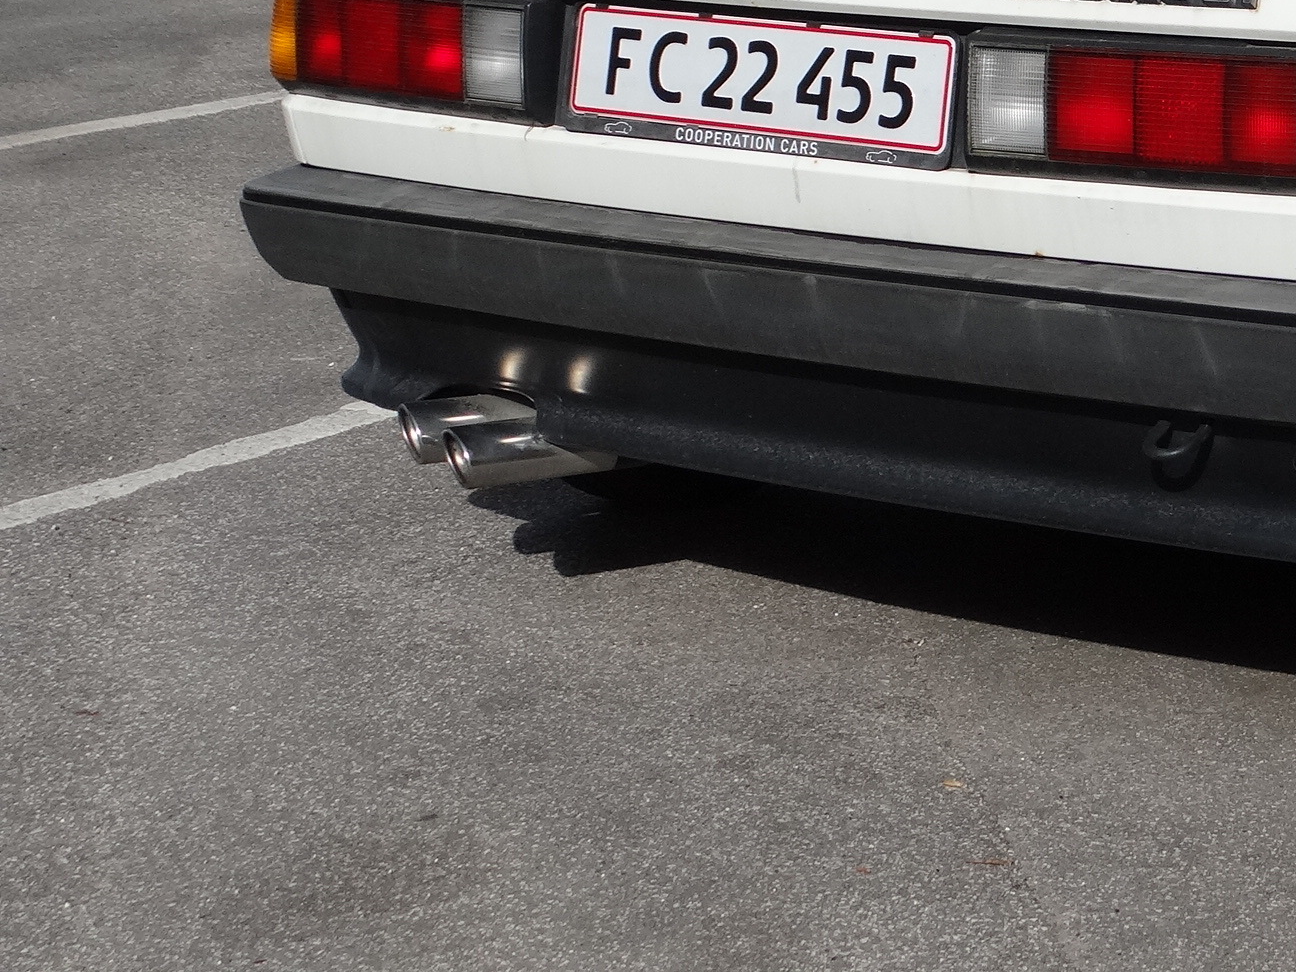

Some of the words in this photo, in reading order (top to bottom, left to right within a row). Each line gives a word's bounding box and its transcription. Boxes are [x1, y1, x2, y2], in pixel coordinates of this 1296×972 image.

[605, 26, 689, 104] FC
[701, 36, 779, 115] 22
[795, 47, 917, 130] 455
[675, 127, 775, 151] COOPERATION
[780, 139, 818, 156] CARS
